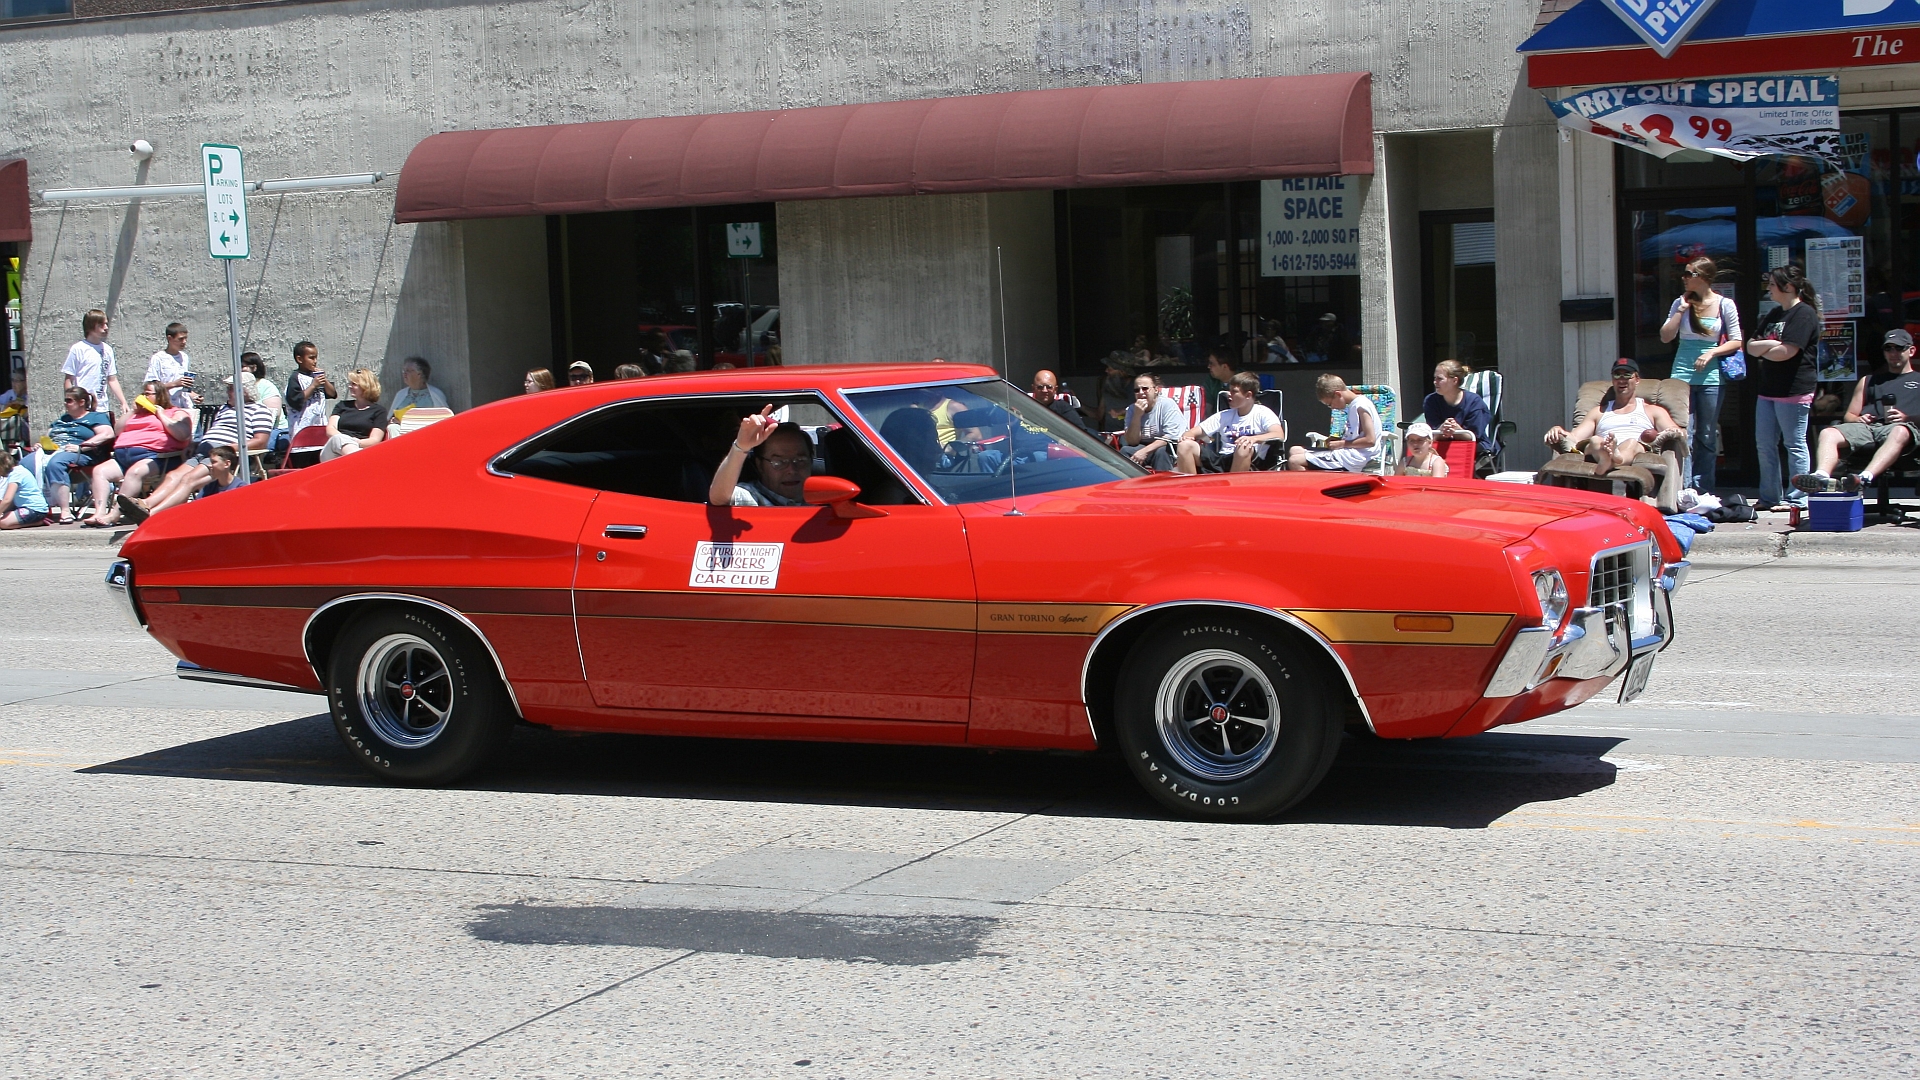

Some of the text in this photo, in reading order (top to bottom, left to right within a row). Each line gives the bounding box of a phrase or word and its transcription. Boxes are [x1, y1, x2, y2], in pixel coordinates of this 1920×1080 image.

[1644, 0, 1696, 37] Piz
[1852, 34, 1903, 58] The
[1707, 79, 1825, 104] SPECIAL
[1759, 109, 1833, 119] Limited Time Offer
[1780, 118, 1833, 126] Details Inside
[1839, 143, 1868, 156] AME
[208, 153, 239, 188] PARKING
[1282, 175, 1345, 191] RETAIL
[218, 193, 234, 205] LOTS
[1283, 196, 1344, 220] SPACE
[1267, 230, 1294, 248] 1,000
[1302, 229, 1330, 247] 2,000
[1332, 228, 1347, 243] SQ
[1271, 253, 1357, 271] 1-612-750-5944
[700, 546, 776, 557] SATURDAY NIGHT
[705, 556, 766, 570] CRUISERS
[694, 573, 770, 586] CAR CLUB
[990, 613, 1088, 624] GRAN TORINO Sport
